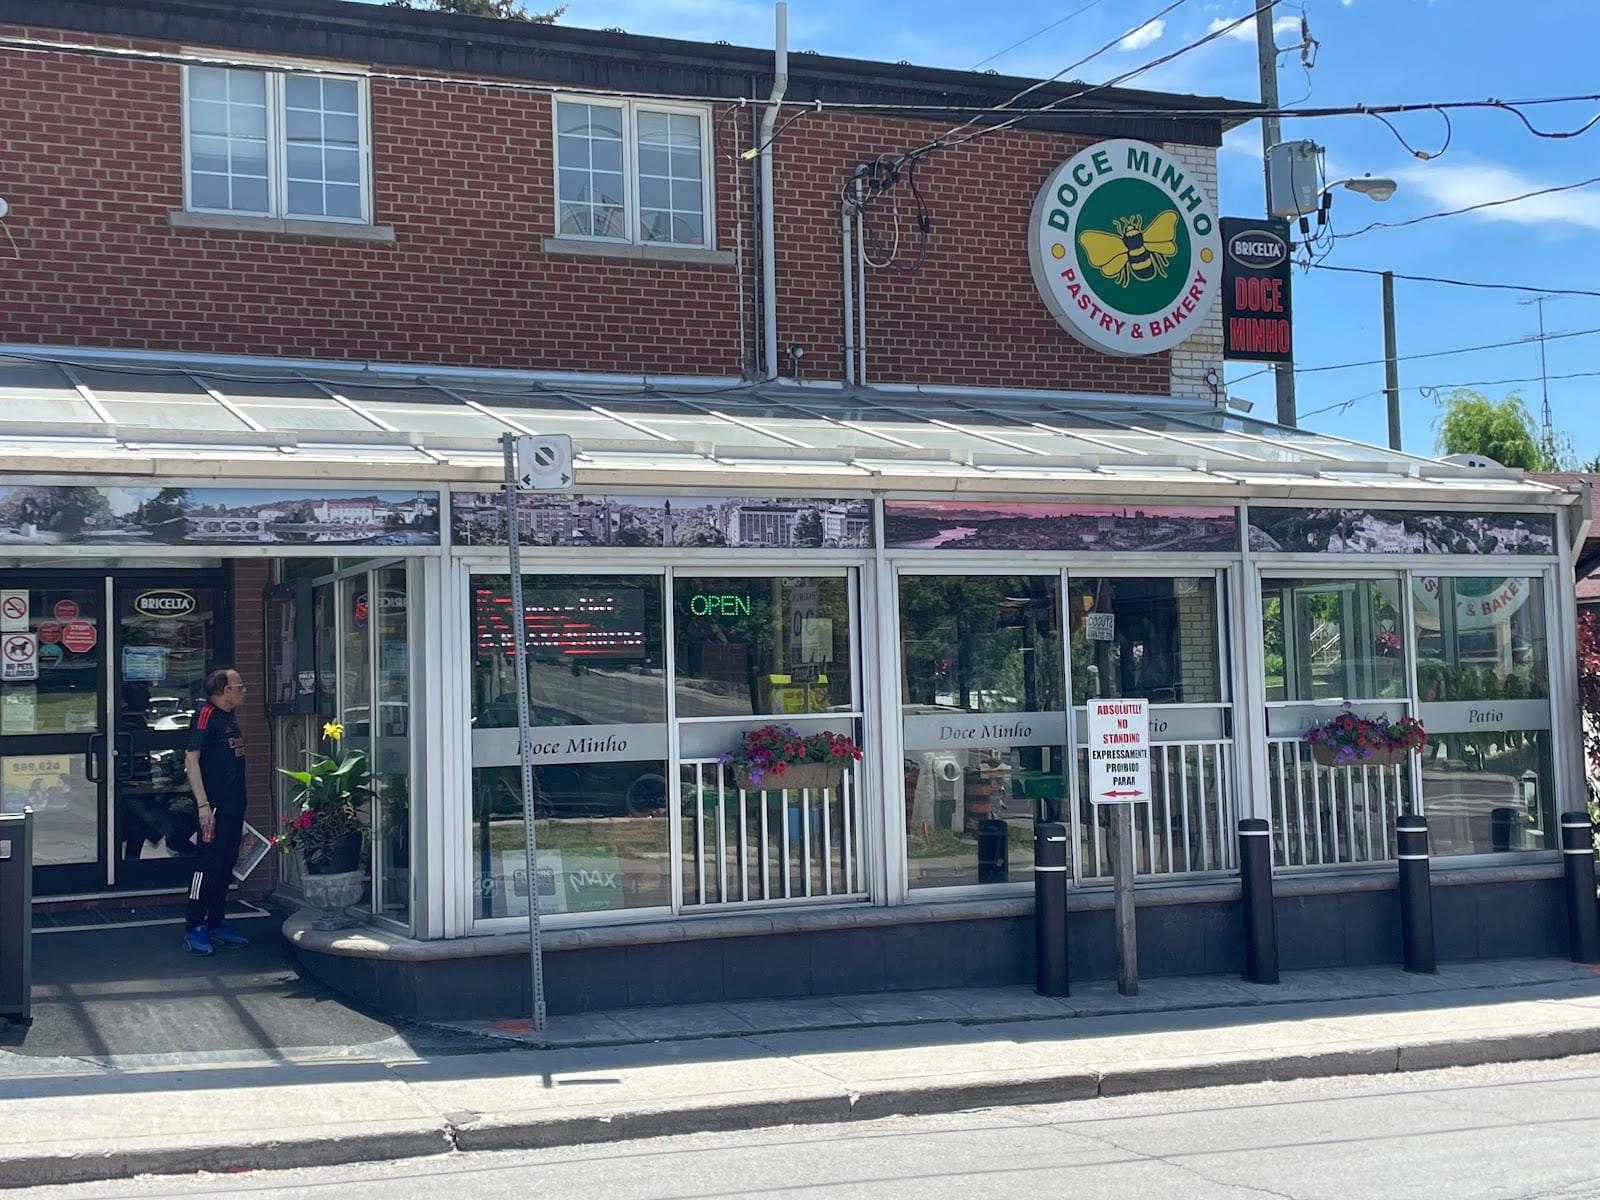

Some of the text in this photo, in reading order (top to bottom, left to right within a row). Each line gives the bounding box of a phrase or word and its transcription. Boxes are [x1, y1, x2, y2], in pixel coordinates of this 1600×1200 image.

[1048, 147, 1212, 236] DOCE MINHO
[1235, 241, 1281, 257] BRICELTA
[1235, 276, 1283, 313] DOCE
[1061, 268, 1208, 339] PASTRY & BAKERY
[1229, 317, 1290, 353] MINHO
[140, 598, 190, 609] BRICELTA
[690, 594, 751, 616] OPEN
[1097, 704, 1142, 715] ABSOLUTELY
[1469, 709, 1503, 723] Patio
[940, 721, 1032, 740] Doce Minho
[1117, 719, 1128, 729] NO
[565, 734, 627, 754] Minho
[1103, 733, 1140, 744] STANDING
[1092, 749, 1147, 760] EXPRESSAMENTE
[1106, 763, 1140, 773] PROIBIDO
[1113, 776, 1135, 786] PARAR
[570, 869, 617, 893] MAX
